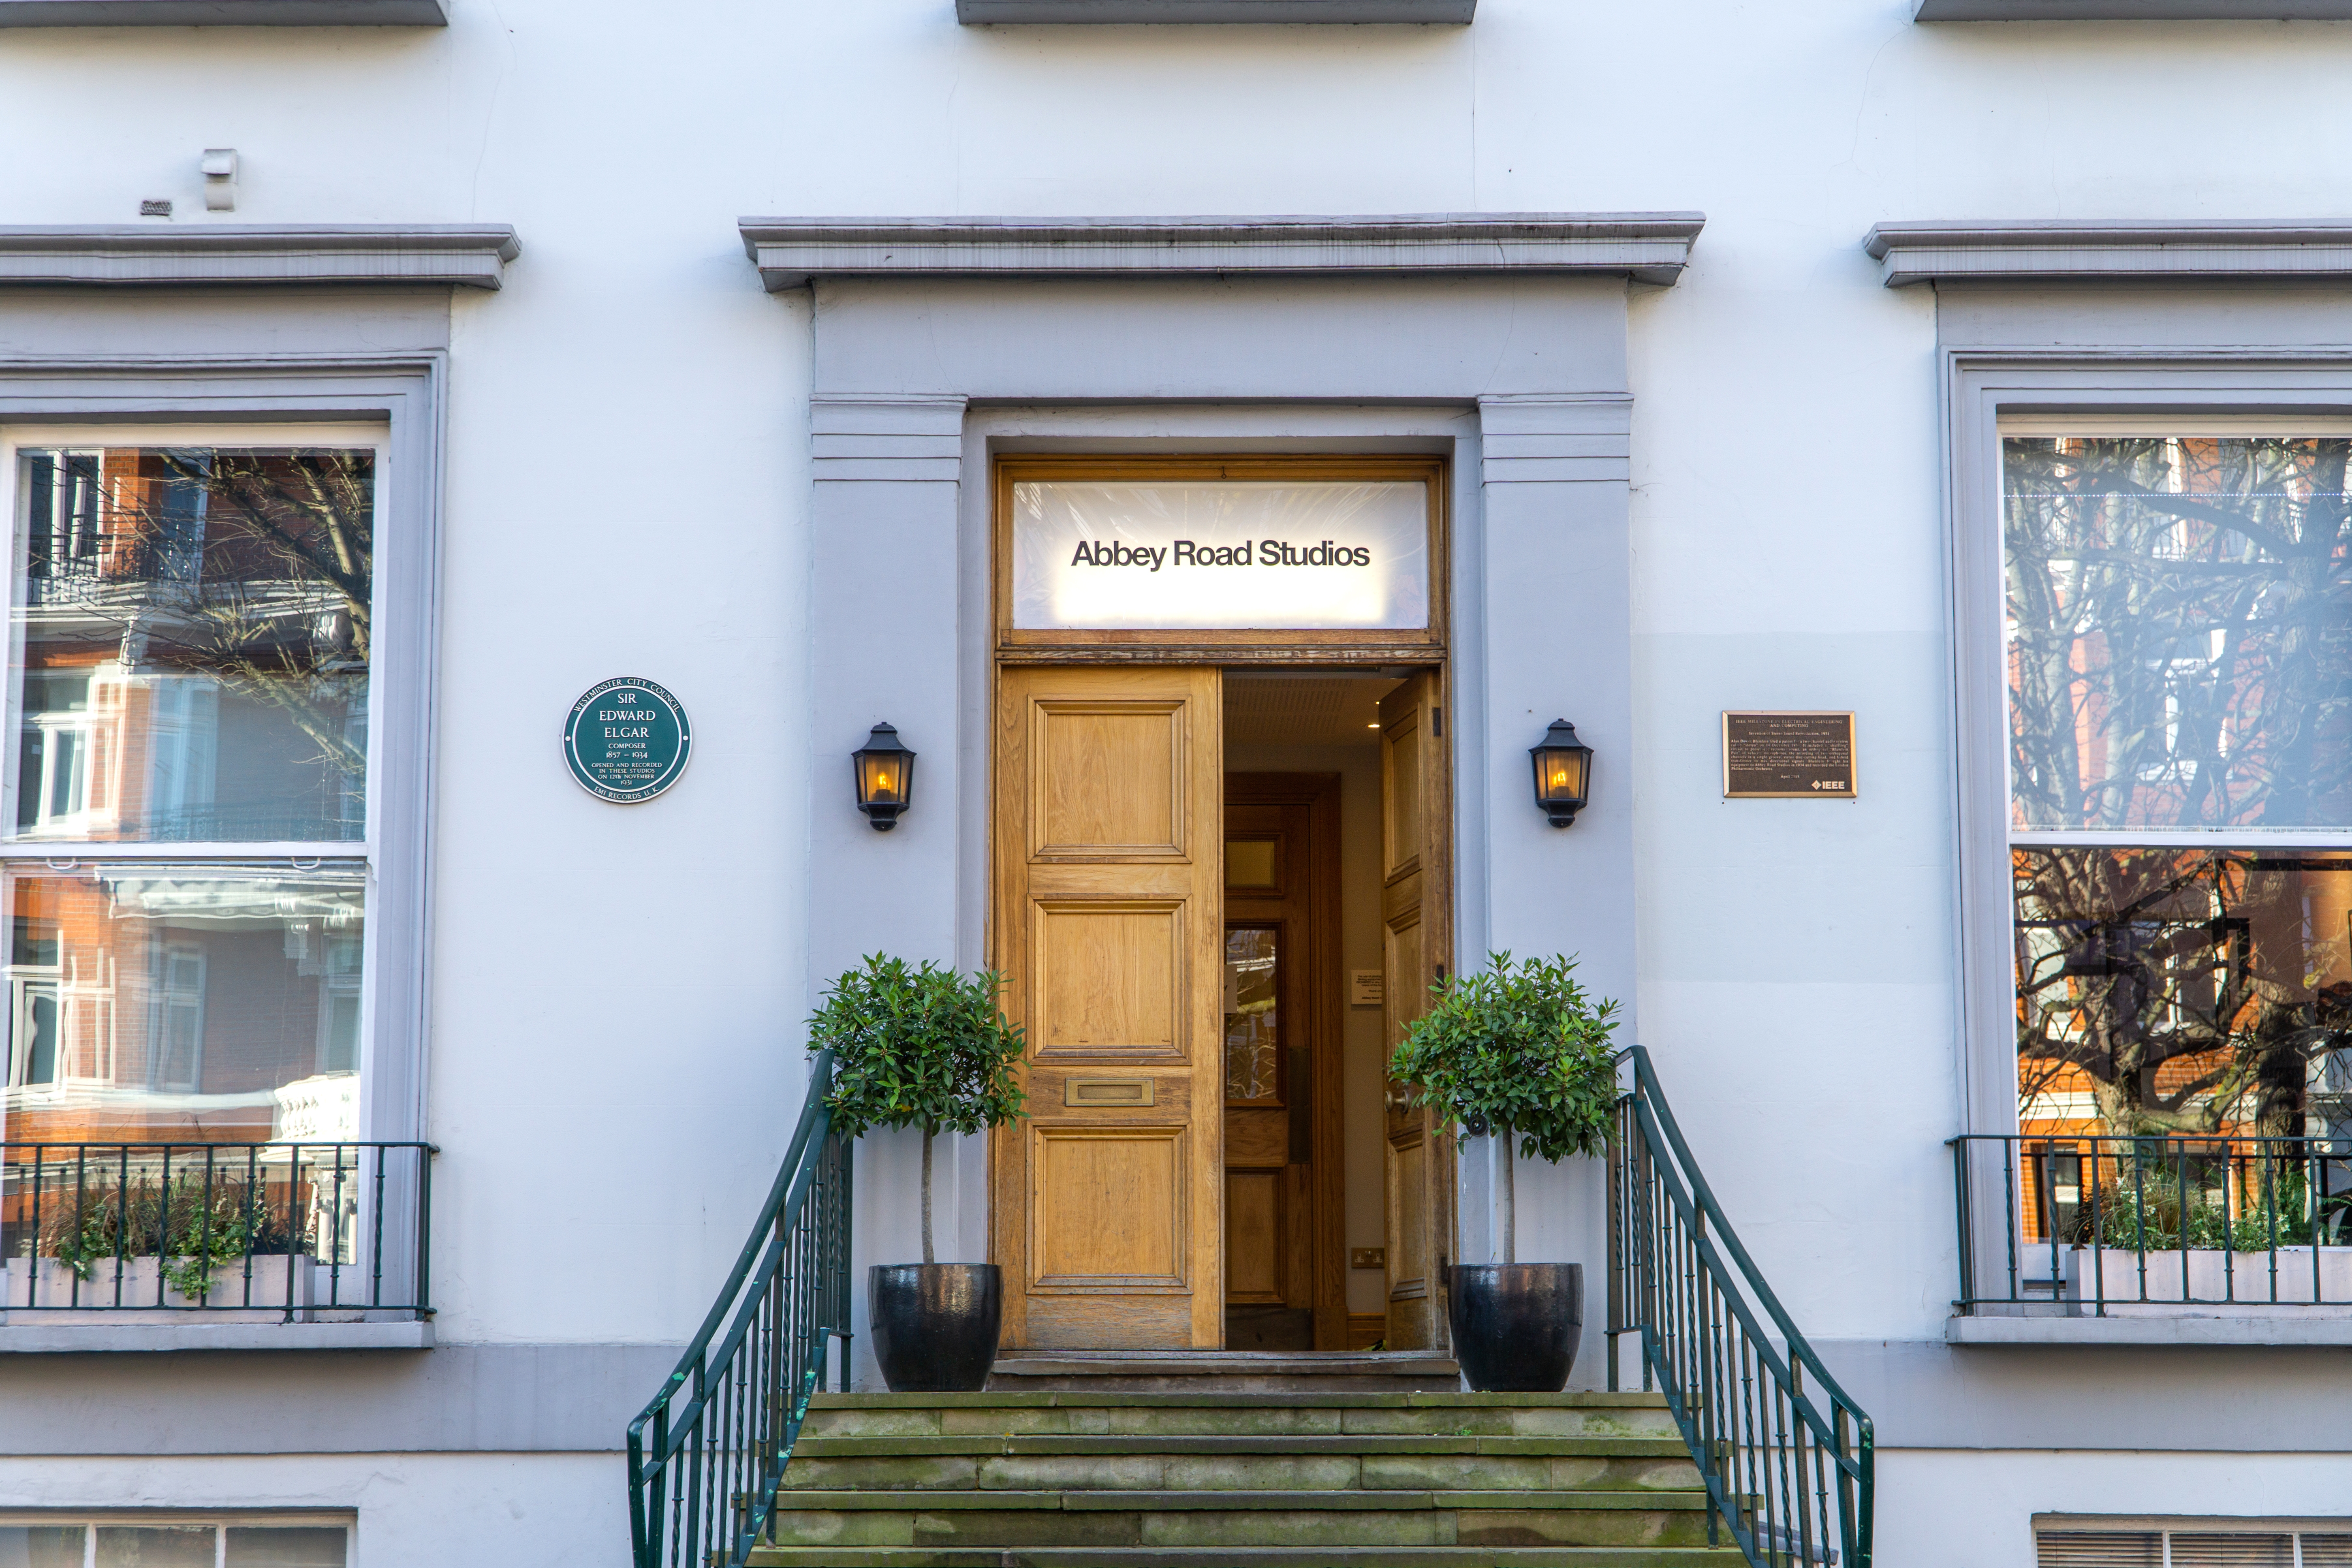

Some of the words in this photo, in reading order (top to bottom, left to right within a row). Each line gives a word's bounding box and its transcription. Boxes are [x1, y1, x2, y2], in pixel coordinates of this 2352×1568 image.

[1071, 540, 1168, 572] Abbey
[1174, 540, 1252, 566] Road
[1259, 540, 1370, 566] Studios
[573, 679, 622, 713] WESTMINSTER
[627, 678, 647, 687] CITY
[650, 684, 681, 712] COUNCIL
[618, 693, 637, 704] SIR
[599, 710, 656, 721] EDWARD
[604, 727, 649, 738] ELGAR
[1822, 781, 1845, 789] IEEE
[594, 786, 606, 796] EMI
